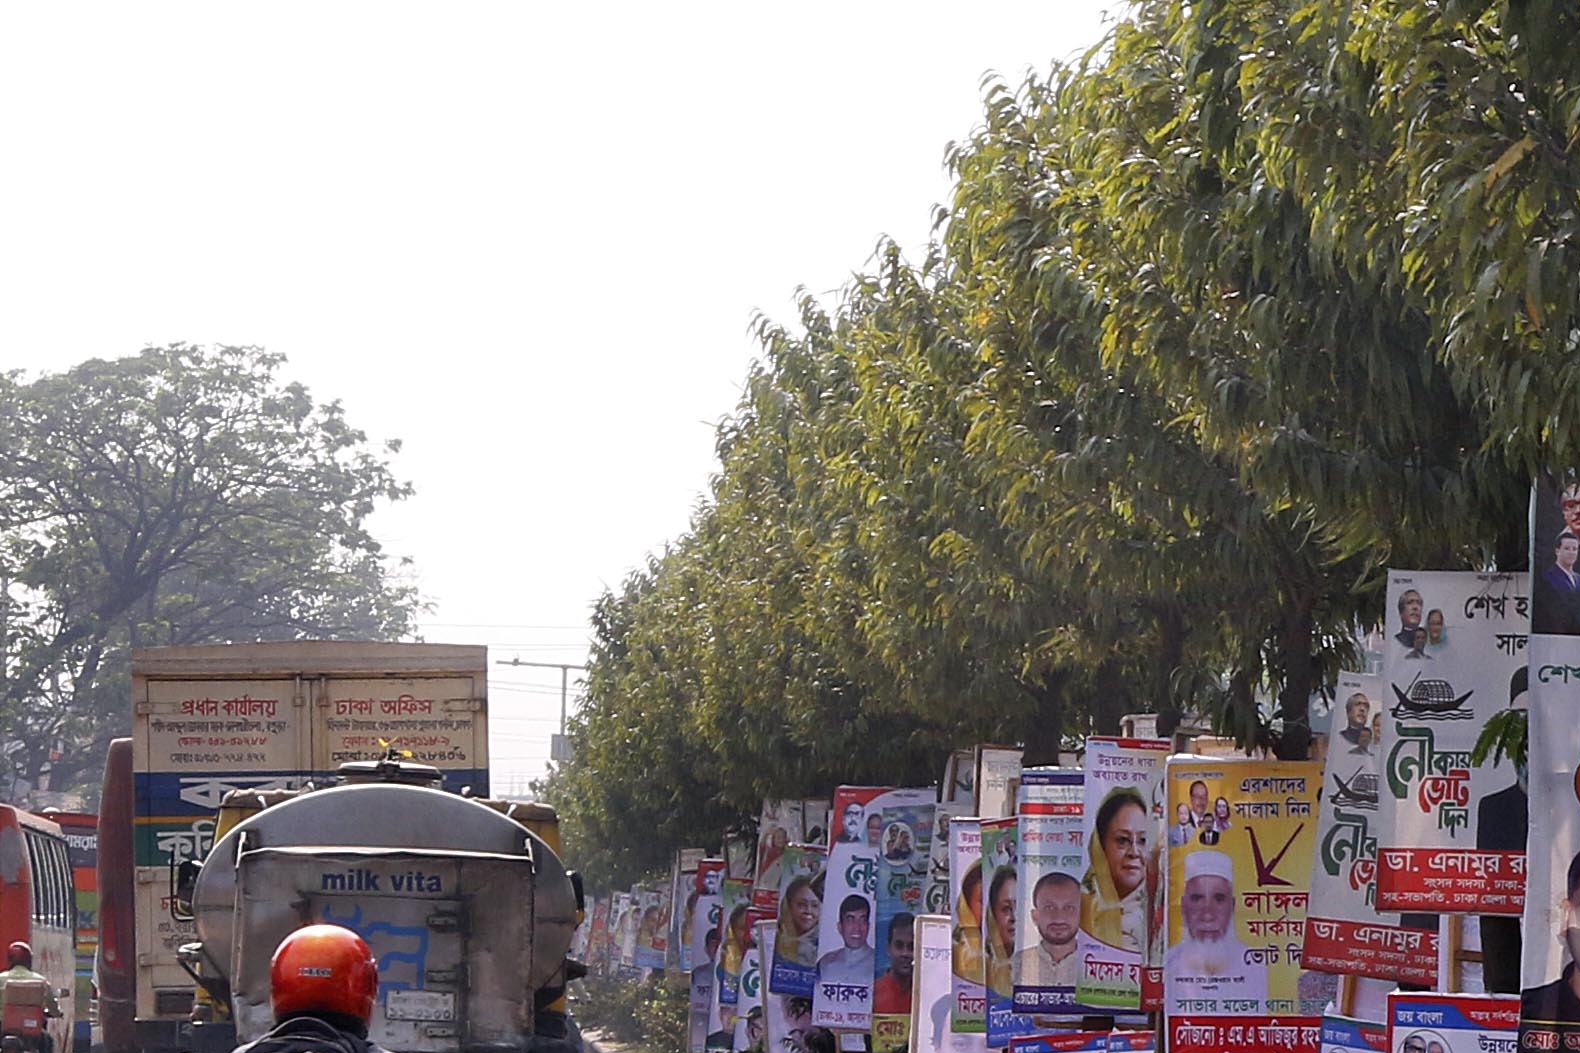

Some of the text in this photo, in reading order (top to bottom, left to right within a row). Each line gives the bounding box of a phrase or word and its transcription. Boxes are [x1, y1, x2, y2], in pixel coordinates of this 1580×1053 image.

[1464, 595, 1508, 620] শেখ
[181, 698, 218, 716] প্রধান
[336, 694, 435, 715] ঢাকা অফিস
[1239, 777, 1306, 794] এরশাদের
[1418, 769, 1471, 813] ভোট
[1235, 797, 1311, 818] সালাম নিন
[1438, 802, 1469, 838] দিন
[1384, 852, 1502, 879] ডা. এনামুর
[322, 869, 442, 893] milk vita
[1247, 916, 1305, 937] মার্কায়
[1314, 922, 1423, 953] ডা. এনামুর
[1243, 945, 1280, 966] ভোট
[1084, 954, 1124, 982] মিসেস
[1176, 999, 1217, 1013] সাভার
[1222, 999, 1259, 1013] মডেল
[1397, 1010, 1443, 1024] জয় বাংলা
[1522, 1030, 1561, 1049] মোঃ
